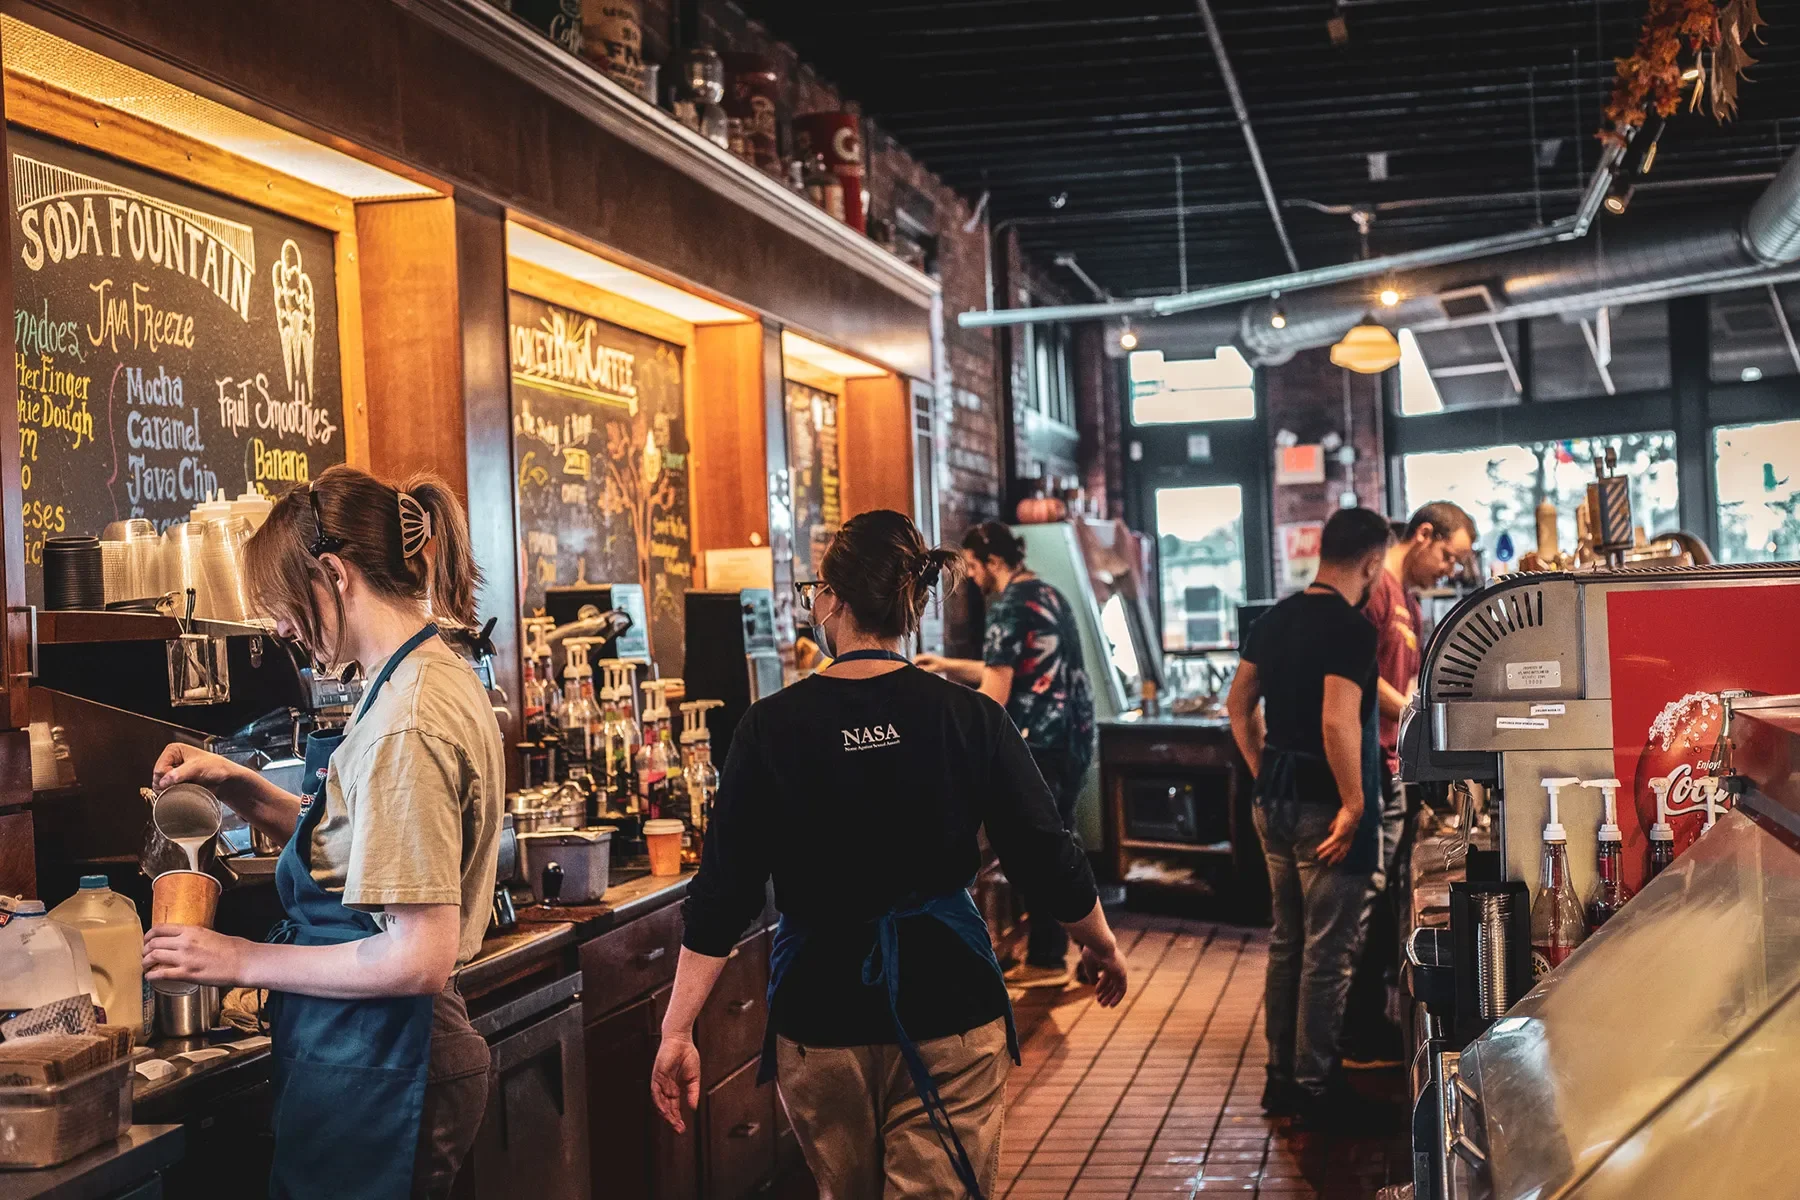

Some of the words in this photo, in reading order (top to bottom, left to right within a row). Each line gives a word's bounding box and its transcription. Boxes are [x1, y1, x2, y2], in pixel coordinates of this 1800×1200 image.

[21, 197, 103, 272] SODA
[108, 196, 253, 323] FOUNTAIN
[126, 366, 184, 408] Mocha
[255, 372, 337, 447] Smoothies
[42, 394, 94, 450] Dough
[126, 407, 204, 451] Caramel
[126, 453, 177, 504] Java
[254, 437, 309, 484] Banana
[841, 722, 901, 746] NASA
[1695, 759, 1722, 771] Enjoy!
